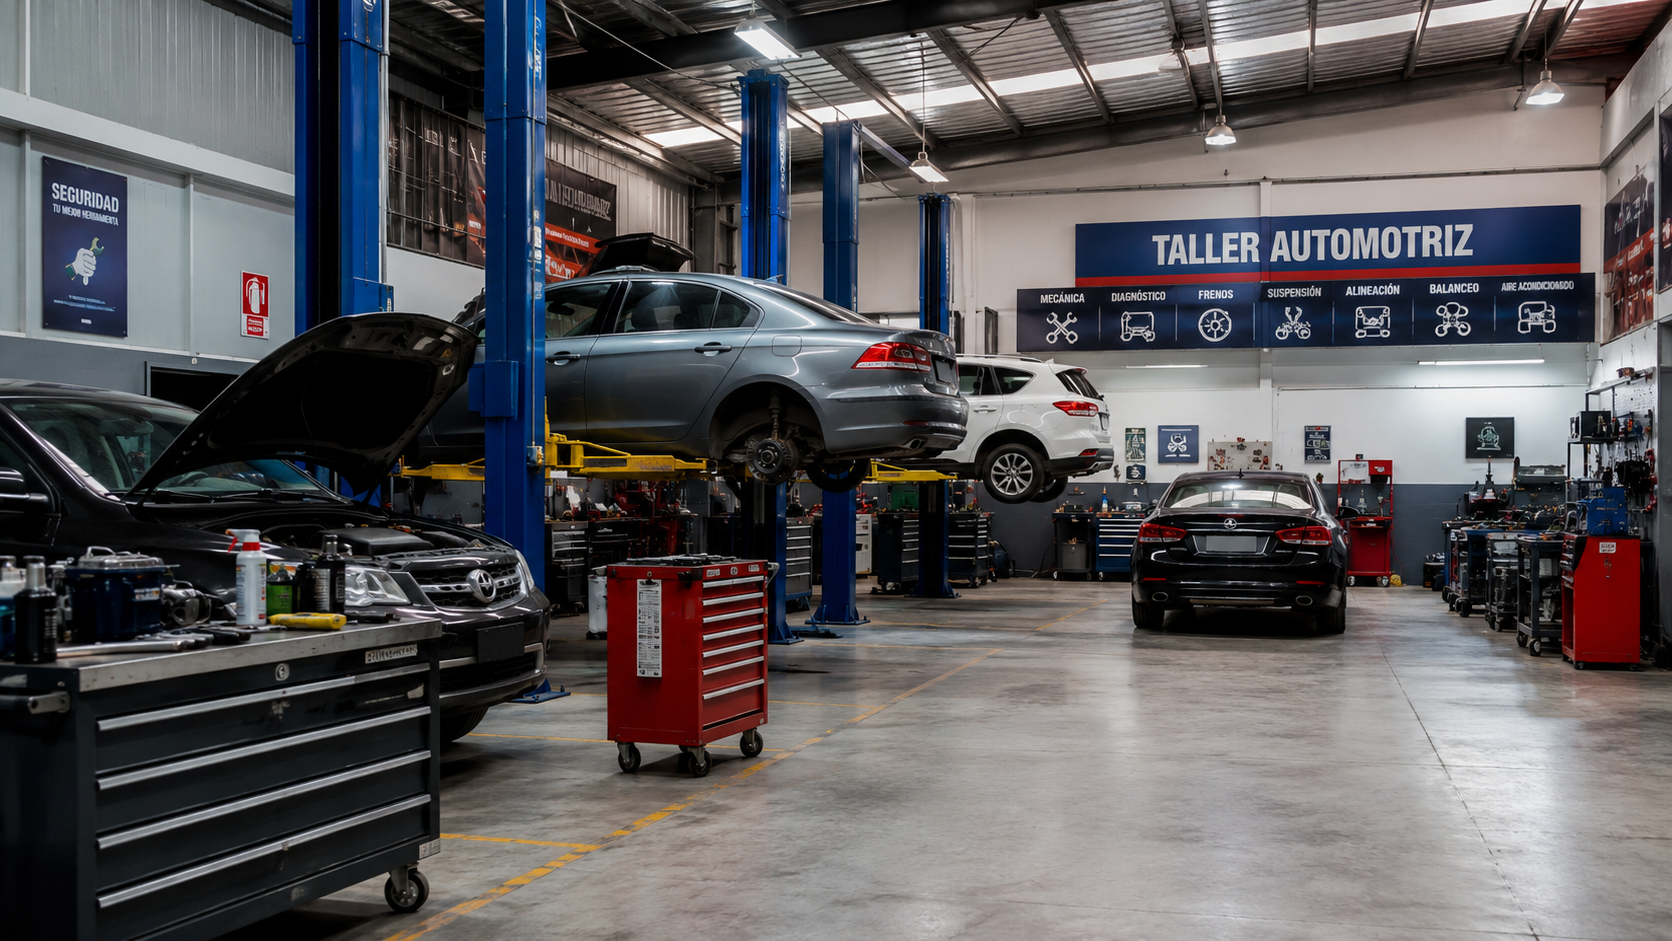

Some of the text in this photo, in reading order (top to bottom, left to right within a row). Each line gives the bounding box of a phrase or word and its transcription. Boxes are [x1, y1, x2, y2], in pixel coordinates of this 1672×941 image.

[51, 182, 119, 213] SEGURIDAD
[52, 203, 61, 214] TU
[1152, 223, 1474, 265] TALLER AUTOMOTRIZ
[1198, 289, 1234, 300] FRENOS
[1267, 287, 1322, 298] SUSPENSIÓN
[1346, 282, 1400, 296] ALINEACIÓN
[1429, 282, 1480, 294] BALANCEO
[1040, 291, 1085, 304] MECÁNICA
[1111, 289, 1166, 302] DIAGNÓSTICO
